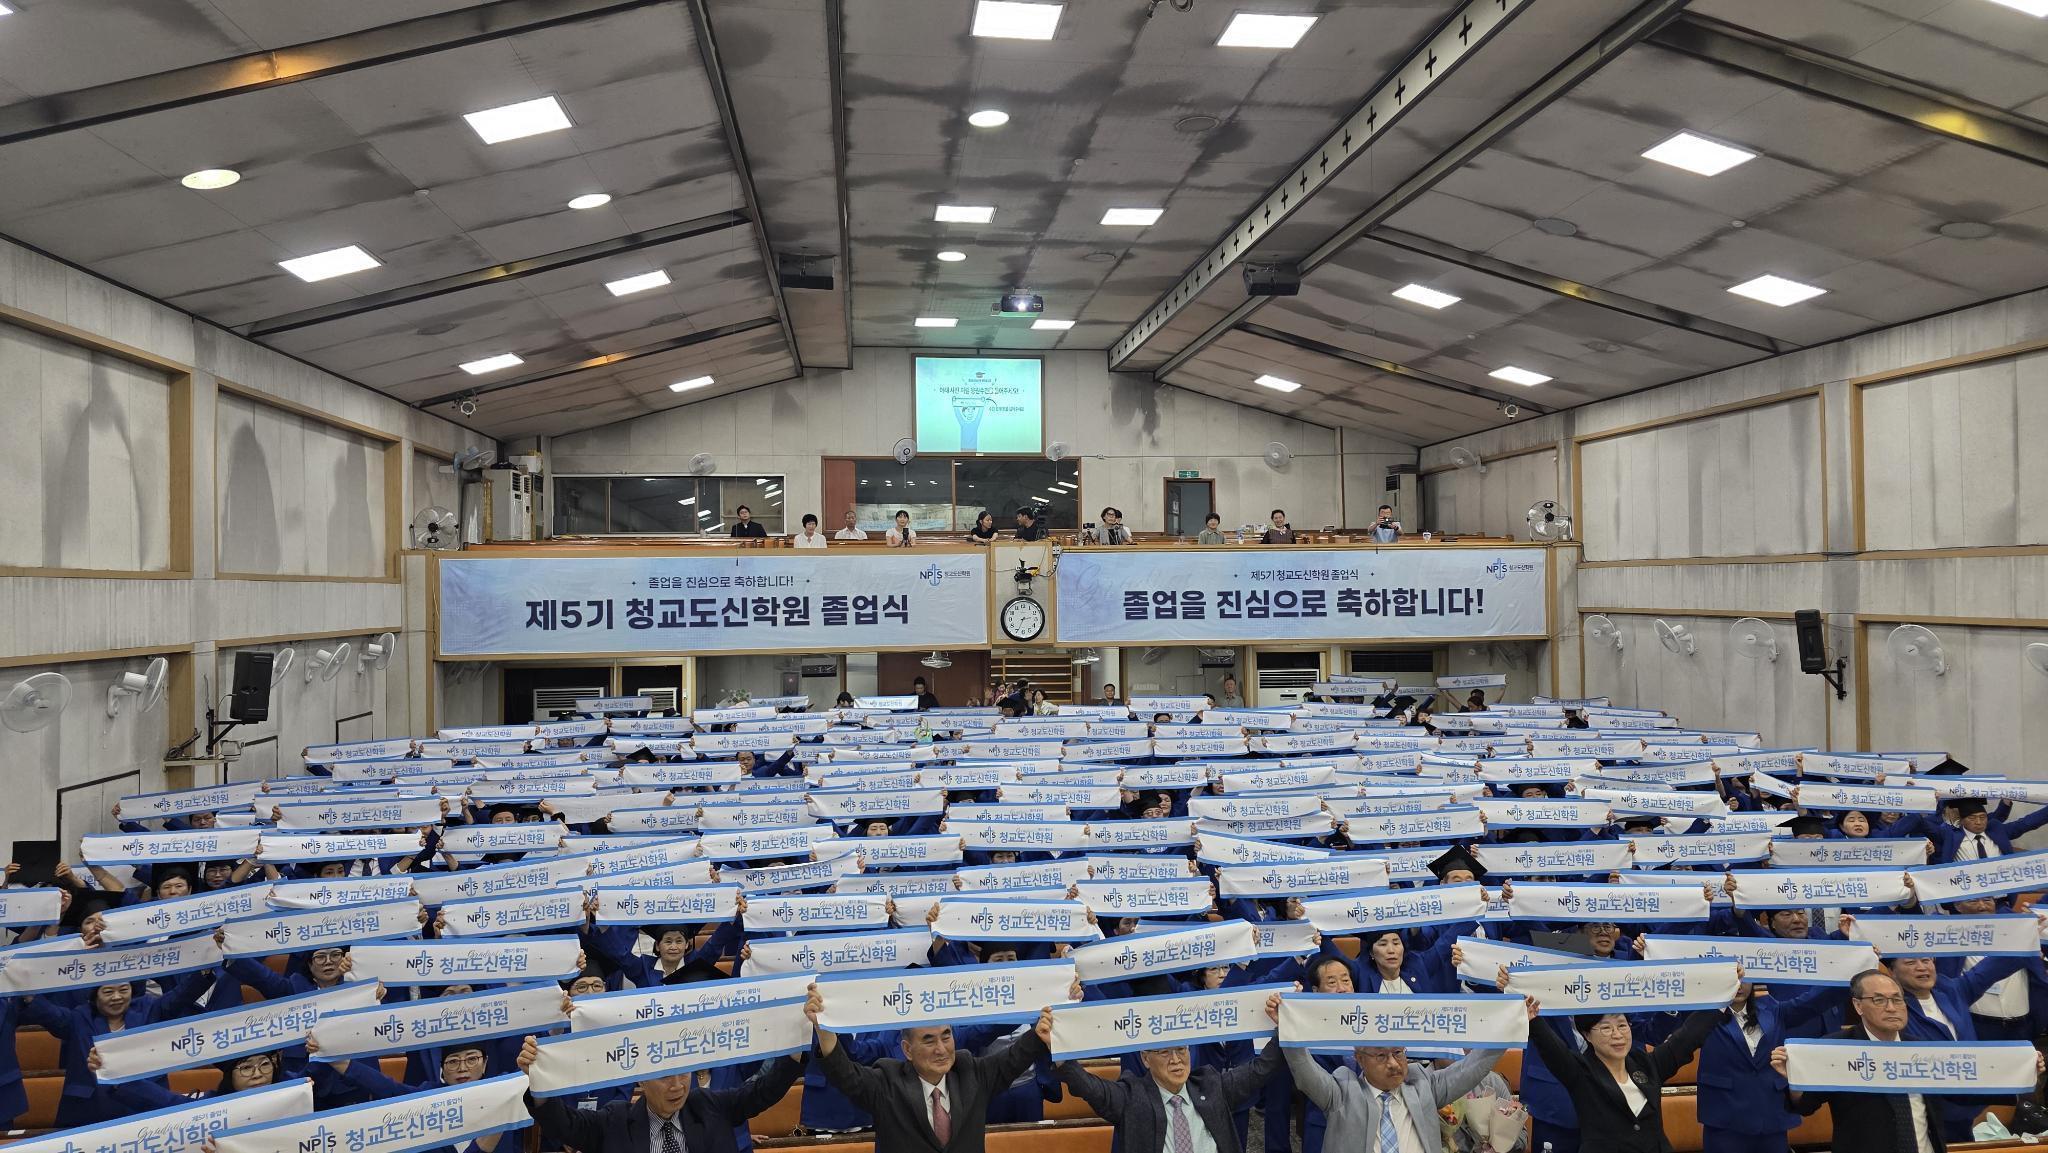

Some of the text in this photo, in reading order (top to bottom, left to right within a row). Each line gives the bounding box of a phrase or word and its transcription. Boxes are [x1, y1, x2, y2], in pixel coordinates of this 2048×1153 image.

[649, 575, 793, 589] 졸업을 진심으로 축하합니다!
[1250, 568, 1359, 581] 제5기 청교도신학원 졸업식
[1122, 588, 1484, 620] 졸업을 진심으로 축하합니다!
[525, 594, 910, 631] 제5기 청교도신학원 졸업식
[732, 738, 770, 748] 청교도신학원
[379, 766, 424, 776] 청교도신학원
[669, 770, 713, 780] 청교도신학원
[955, 772, 999, 783] 청교도신학원
[1526, 767, 1570, 778] 청교도신학원
[1642, 770, 1686, 782] 청교도신학원
[518, 783, 566, 792] 청교도신학원
[1266, 774, 1308, 785] 청교도신학원
[173, 794, 230, 810] 청교도신학원
[859, 799, 910, 810] 청교도신학원
[1045, 793, 1092, 804] 청교도신학원
[1641, 797, 1694, 811] 청교도신학원
[1850, 793, 1904, 806] 청교도신학원
[341, 809, 402, 822] 청교도신학원
[751, 812, 798, 824] 청교도신학원
[1240, 804, 1289, 816] 청교도신학원
[1526, 809, 1578, 820] 청교도신학원
[1248, 820, 1302, 833] 청교도신학원
[1399, 820, 1452, 834] 청교도신학원
[488, 832, 546, 846] 청교도신학원
[751, 835, 808, 850] 청교도신학원
[999, 830, 1054, 844] 청교도신학원
[1115, 828, 1168, 842] 청교도신학원
[148, 840, 218, 855] 청교도신학원
[324, 838, 388, 852] 청교도신학원
[870, 844, 927, 859] 청교도신학원
[1678, 842, 1736, 858] 청교도신학원
[609, 852, 668, 872] 청교도신학원
[1536, 852, 1595, 867] 청교도신학원
[1832, 848, 1893, 862] 청교도신학원
[769, 864, 833, 883] 청교도신학원
[1118, 866, 1178, 880] 청교도신학원
[1391, 861, 1430, 875] 교도신학
[1975, 862, 2048, 888] 청교도신학원
[482, 872, 550, 892] 청교도신학원
[1002, 871, 1062, 890] 청교도신학원
[1286, 869, 1350, 888] 청교도신학원
[336, 882, 408, 904] 청교도신학원
[1126, 890, 1188, 908] 청교도신학원
[1802, 882, 1868, 900] 청교도신학원
[176, 898, 252, 925] 청교도신학원
[644, 898, 716, 914] 청교도신학원
[1373, 901, 1442, 922] 청교도신학원
[1585, 896, 1660, 913] 청교도신학원
[495, 902, 570, 926] 청교도신학원
[798, 904, 868, 922] 청교도신학원
[297, 916, 380, 942] 청교도신학원
[998, 913, 1072, 931] 청교도신학원
[1923, 930, 1994, 948] 청교도신학원
[820, 945, 897, 967] 청교도신학원
[1142, 940, 1216, 968] 청교도신학원
[92, 950, 180, 978] 청교도신학원
[440, 954, 528, 974] 청교도신학원
[920, 982, 1016, 1012] 청교도신학원
[1597, 978, 1685, 1000] 청교도신학원
[212, 1008, 318, 1049] 청교도신학원
[411, 1007, 509, 1038] 청교도신학원
[1148, 1007, 1238, 1036] 청교도신학원
[1375, 1013, 1467, 1034] 청교도신학원
[646, 1025, 750, 1064] 청교도신학원
[1882, 1060, 1978, 1081] 청교도신학원
[345, 1105, 464, 1152] 청교도신학원
